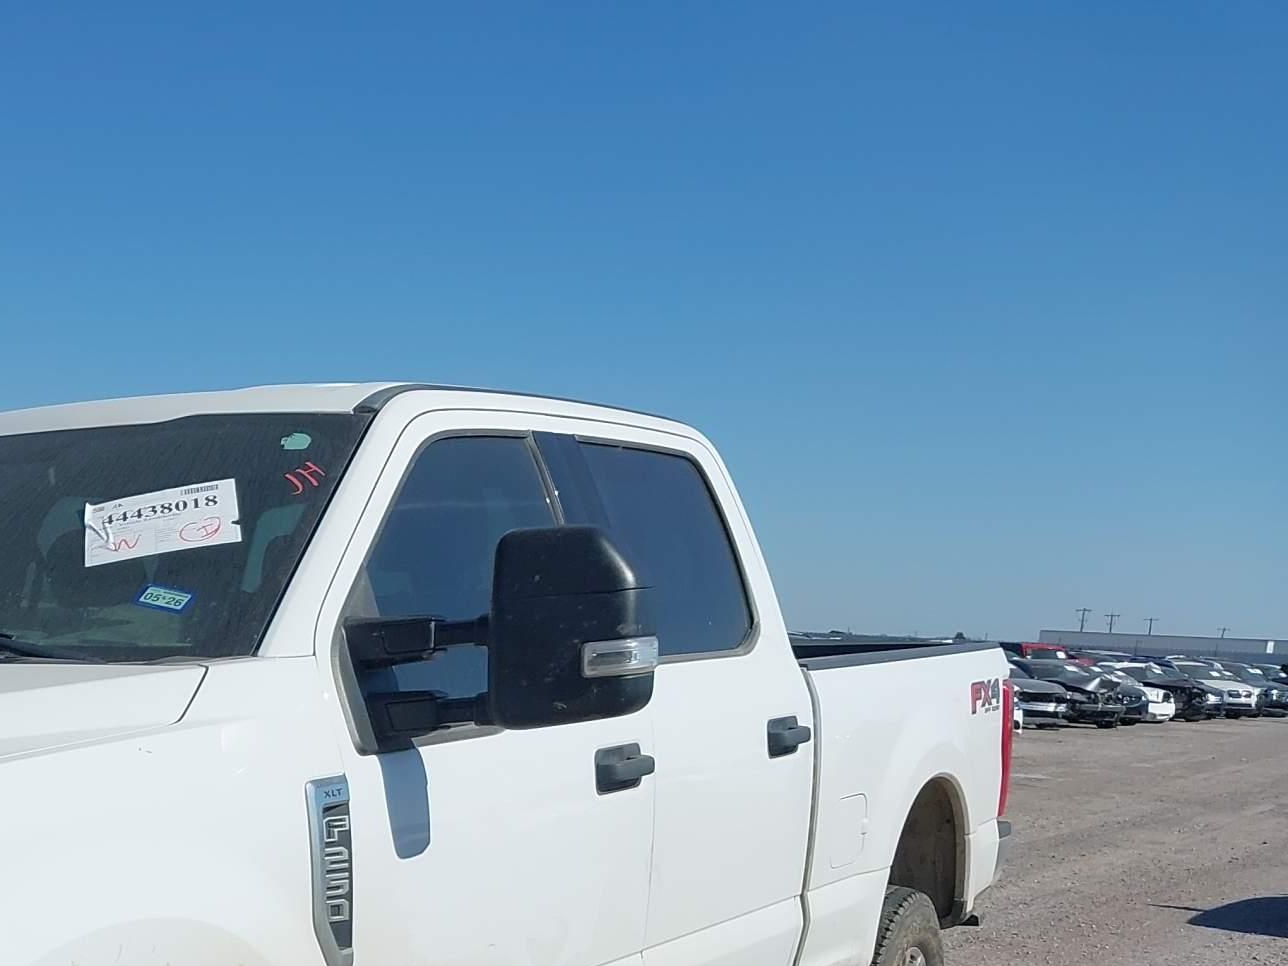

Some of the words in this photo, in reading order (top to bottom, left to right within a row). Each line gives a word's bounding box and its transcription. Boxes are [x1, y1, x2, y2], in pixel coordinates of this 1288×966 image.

[285, 461, 325, 495] JH
[102, 495, 218, 526] 44438018
[143, 592, 162, 602] 05
[164, 596, 184, 607] 26
[970, 678, 1000, 715] FX4
[323, 788, 343, 799] XLT
